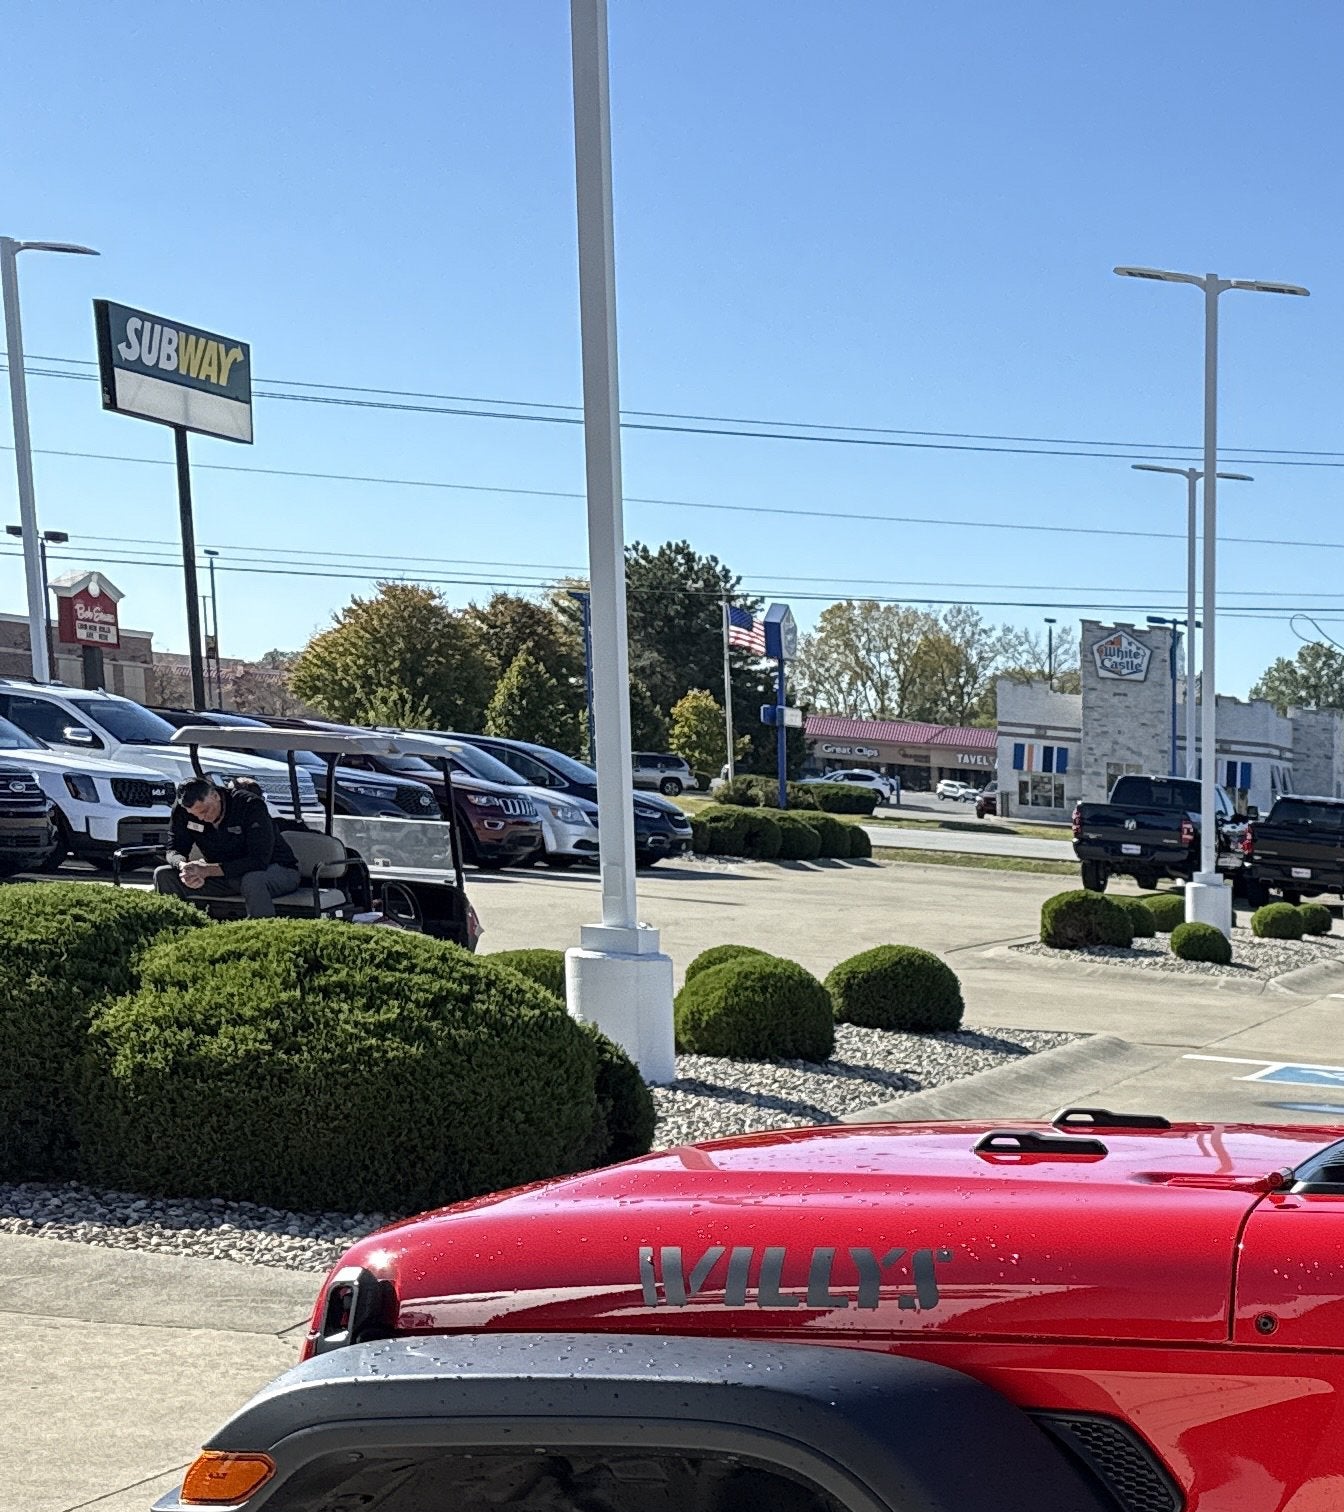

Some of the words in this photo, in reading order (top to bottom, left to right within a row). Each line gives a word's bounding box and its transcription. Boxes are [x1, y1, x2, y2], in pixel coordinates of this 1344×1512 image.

[117, 316, 244, 387] SUBWAY
[1103, 646, 1141, 661] White
[1101, 657, 1143, 671] Castle
[822, 743, 852, 755] Great
[854, 746, 880, 758] Clips
[638, 1246, 953, 1309] WILLYS
